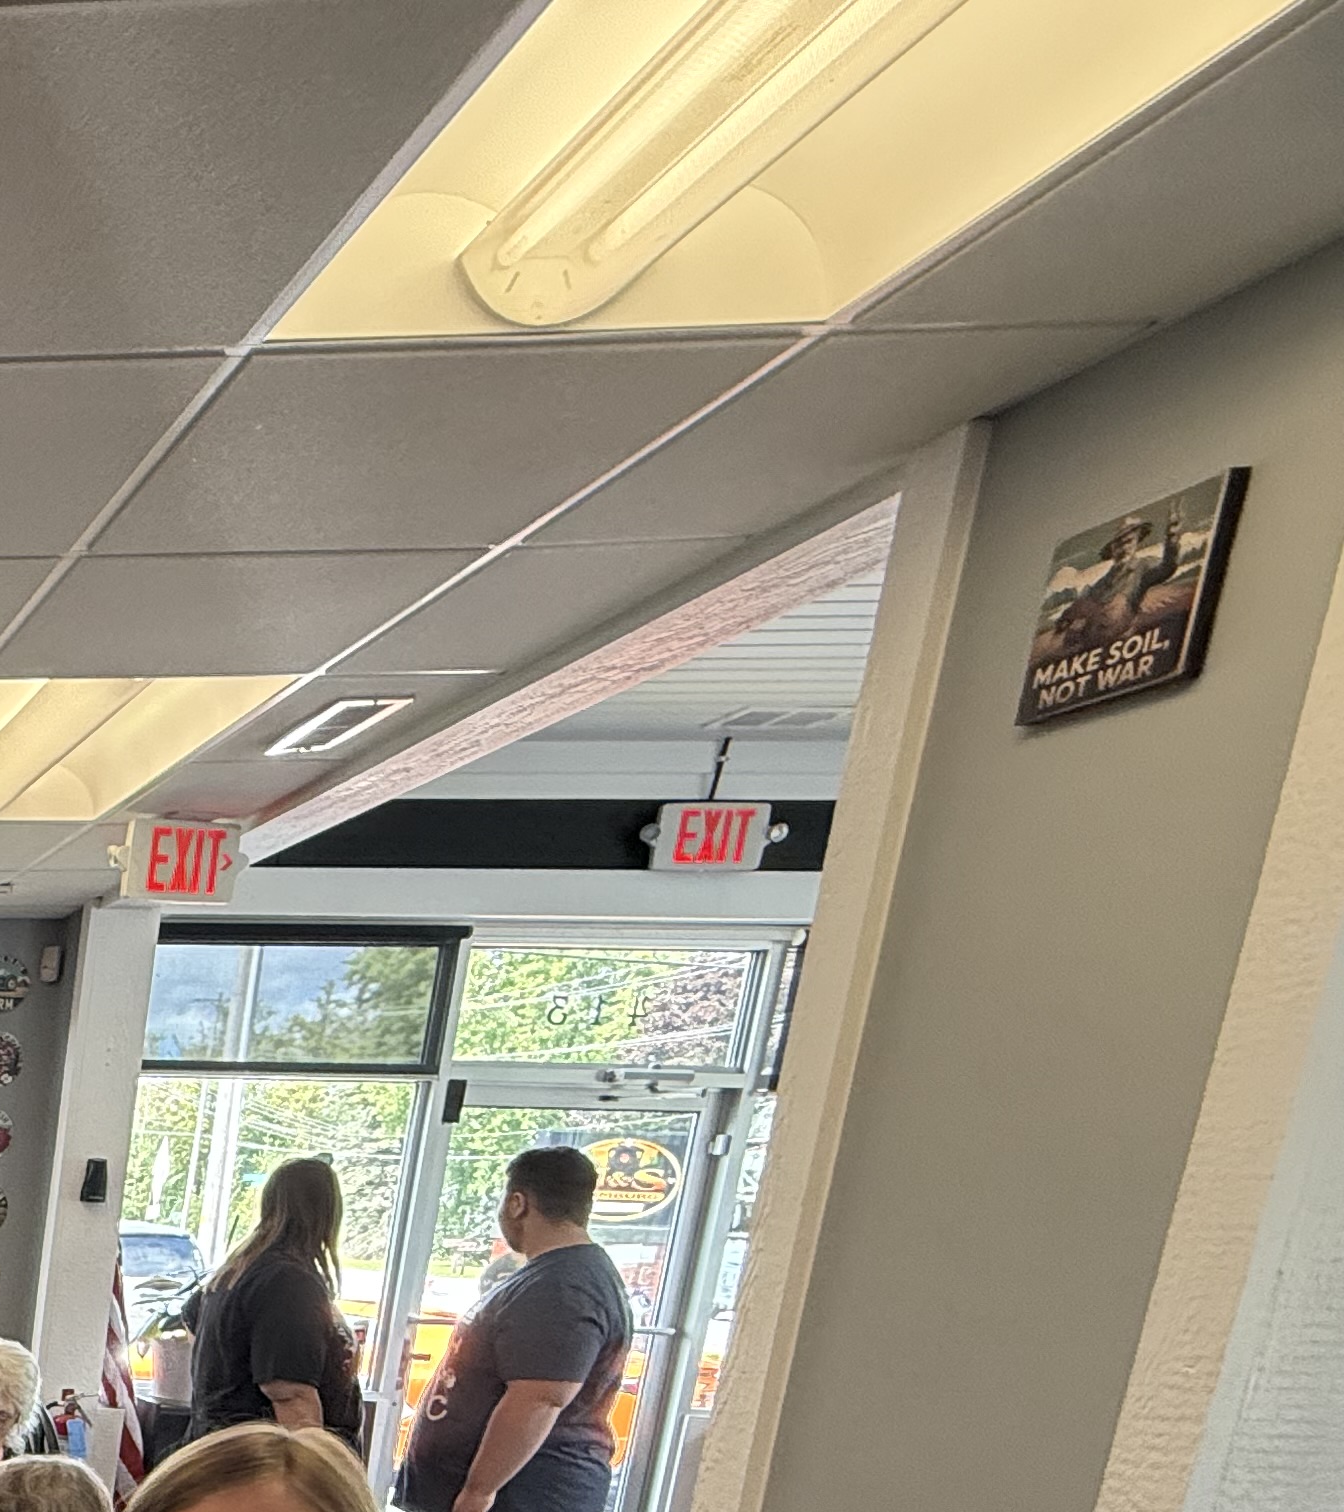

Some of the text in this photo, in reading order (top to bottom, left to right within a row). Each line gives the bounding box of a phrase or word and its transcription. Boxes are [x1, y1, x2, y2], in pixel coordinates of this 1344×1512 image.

[1033, 628, 1170, 689] MAKE SOIL,
[1038, 655, 1154, 709] NOT WAR
[146, 826, 227, 895] EXIT
[672, 809, 757, 864] EXIT
